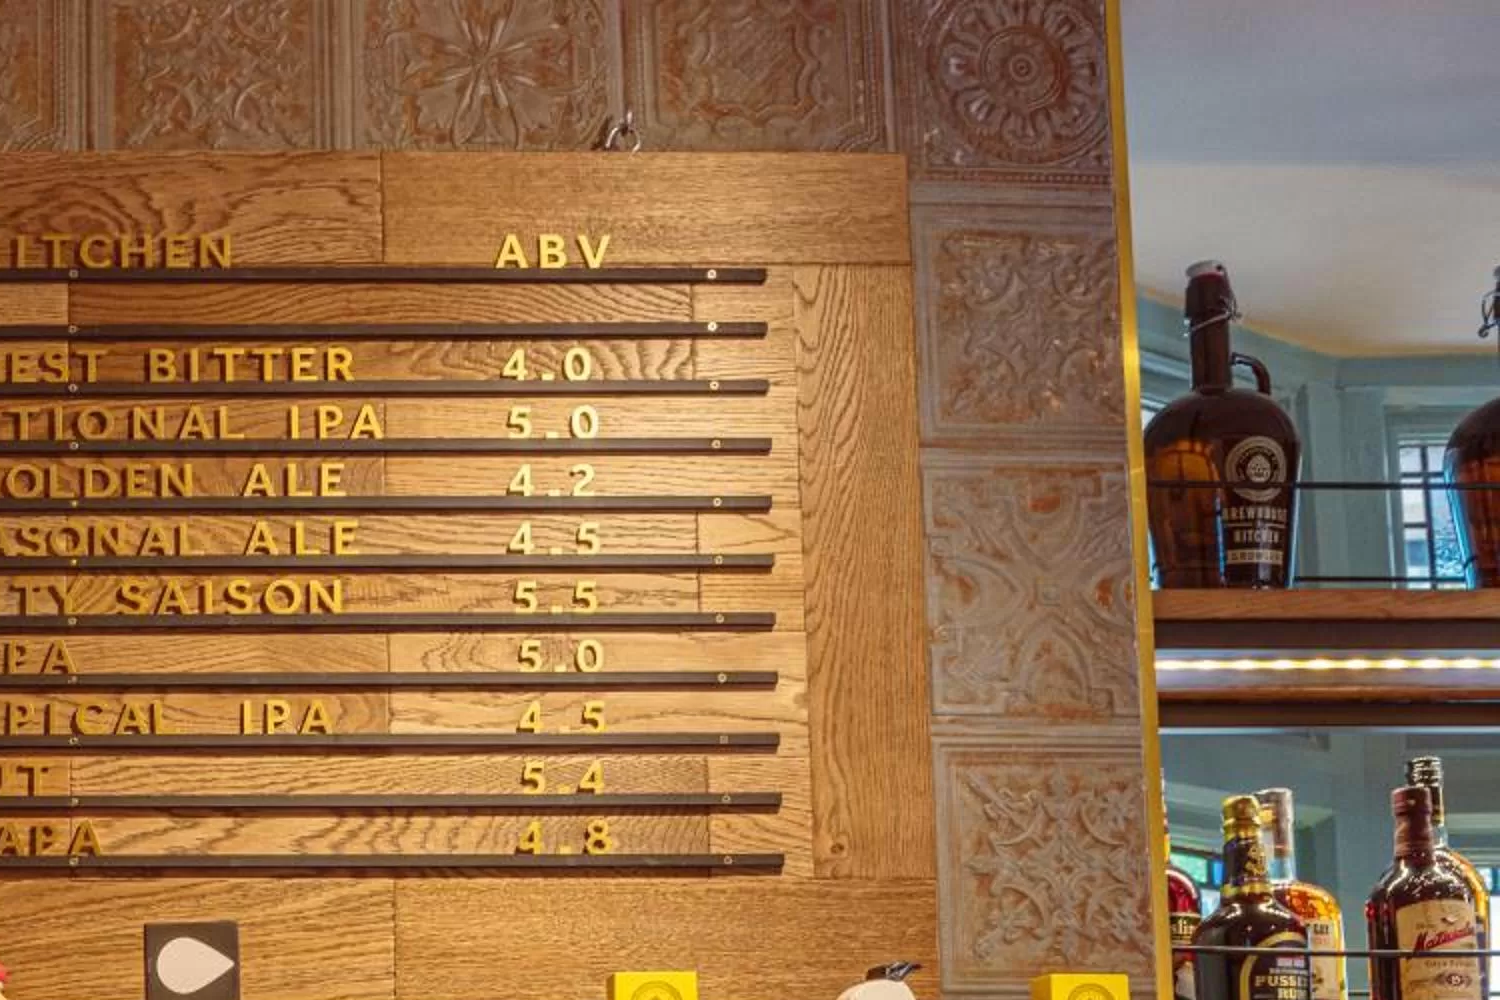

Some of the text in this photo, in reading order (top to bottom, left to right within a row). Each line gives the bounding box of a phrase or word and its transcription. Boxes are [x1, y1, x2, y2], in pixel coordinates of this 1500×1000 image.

[496, 233, 611, 268] ABV
[150, 347, 355, 383] BITTER
[503, 347, 592, 382] 4.0
[289, 405, 384, 440] IPA
[507, 406, 600, 440] 5.0
[245, 463, 347, 498] ALE
[508, 463, 596, 497] 4.2
[245, 521, 360, 556] ALE
[509, 521, 602, 556] 4.5
[115, 579, 343, 616] SAISON
[513, 579, 599, 614] 5.5
[519, 638, 605, 673] 5.0
[241, 699, 334, 735] IPA
[517, 699, 607, 735] 4.5
[521, 760, 606, 796] 5.4
[517, 819, 614, 855] 4.8
